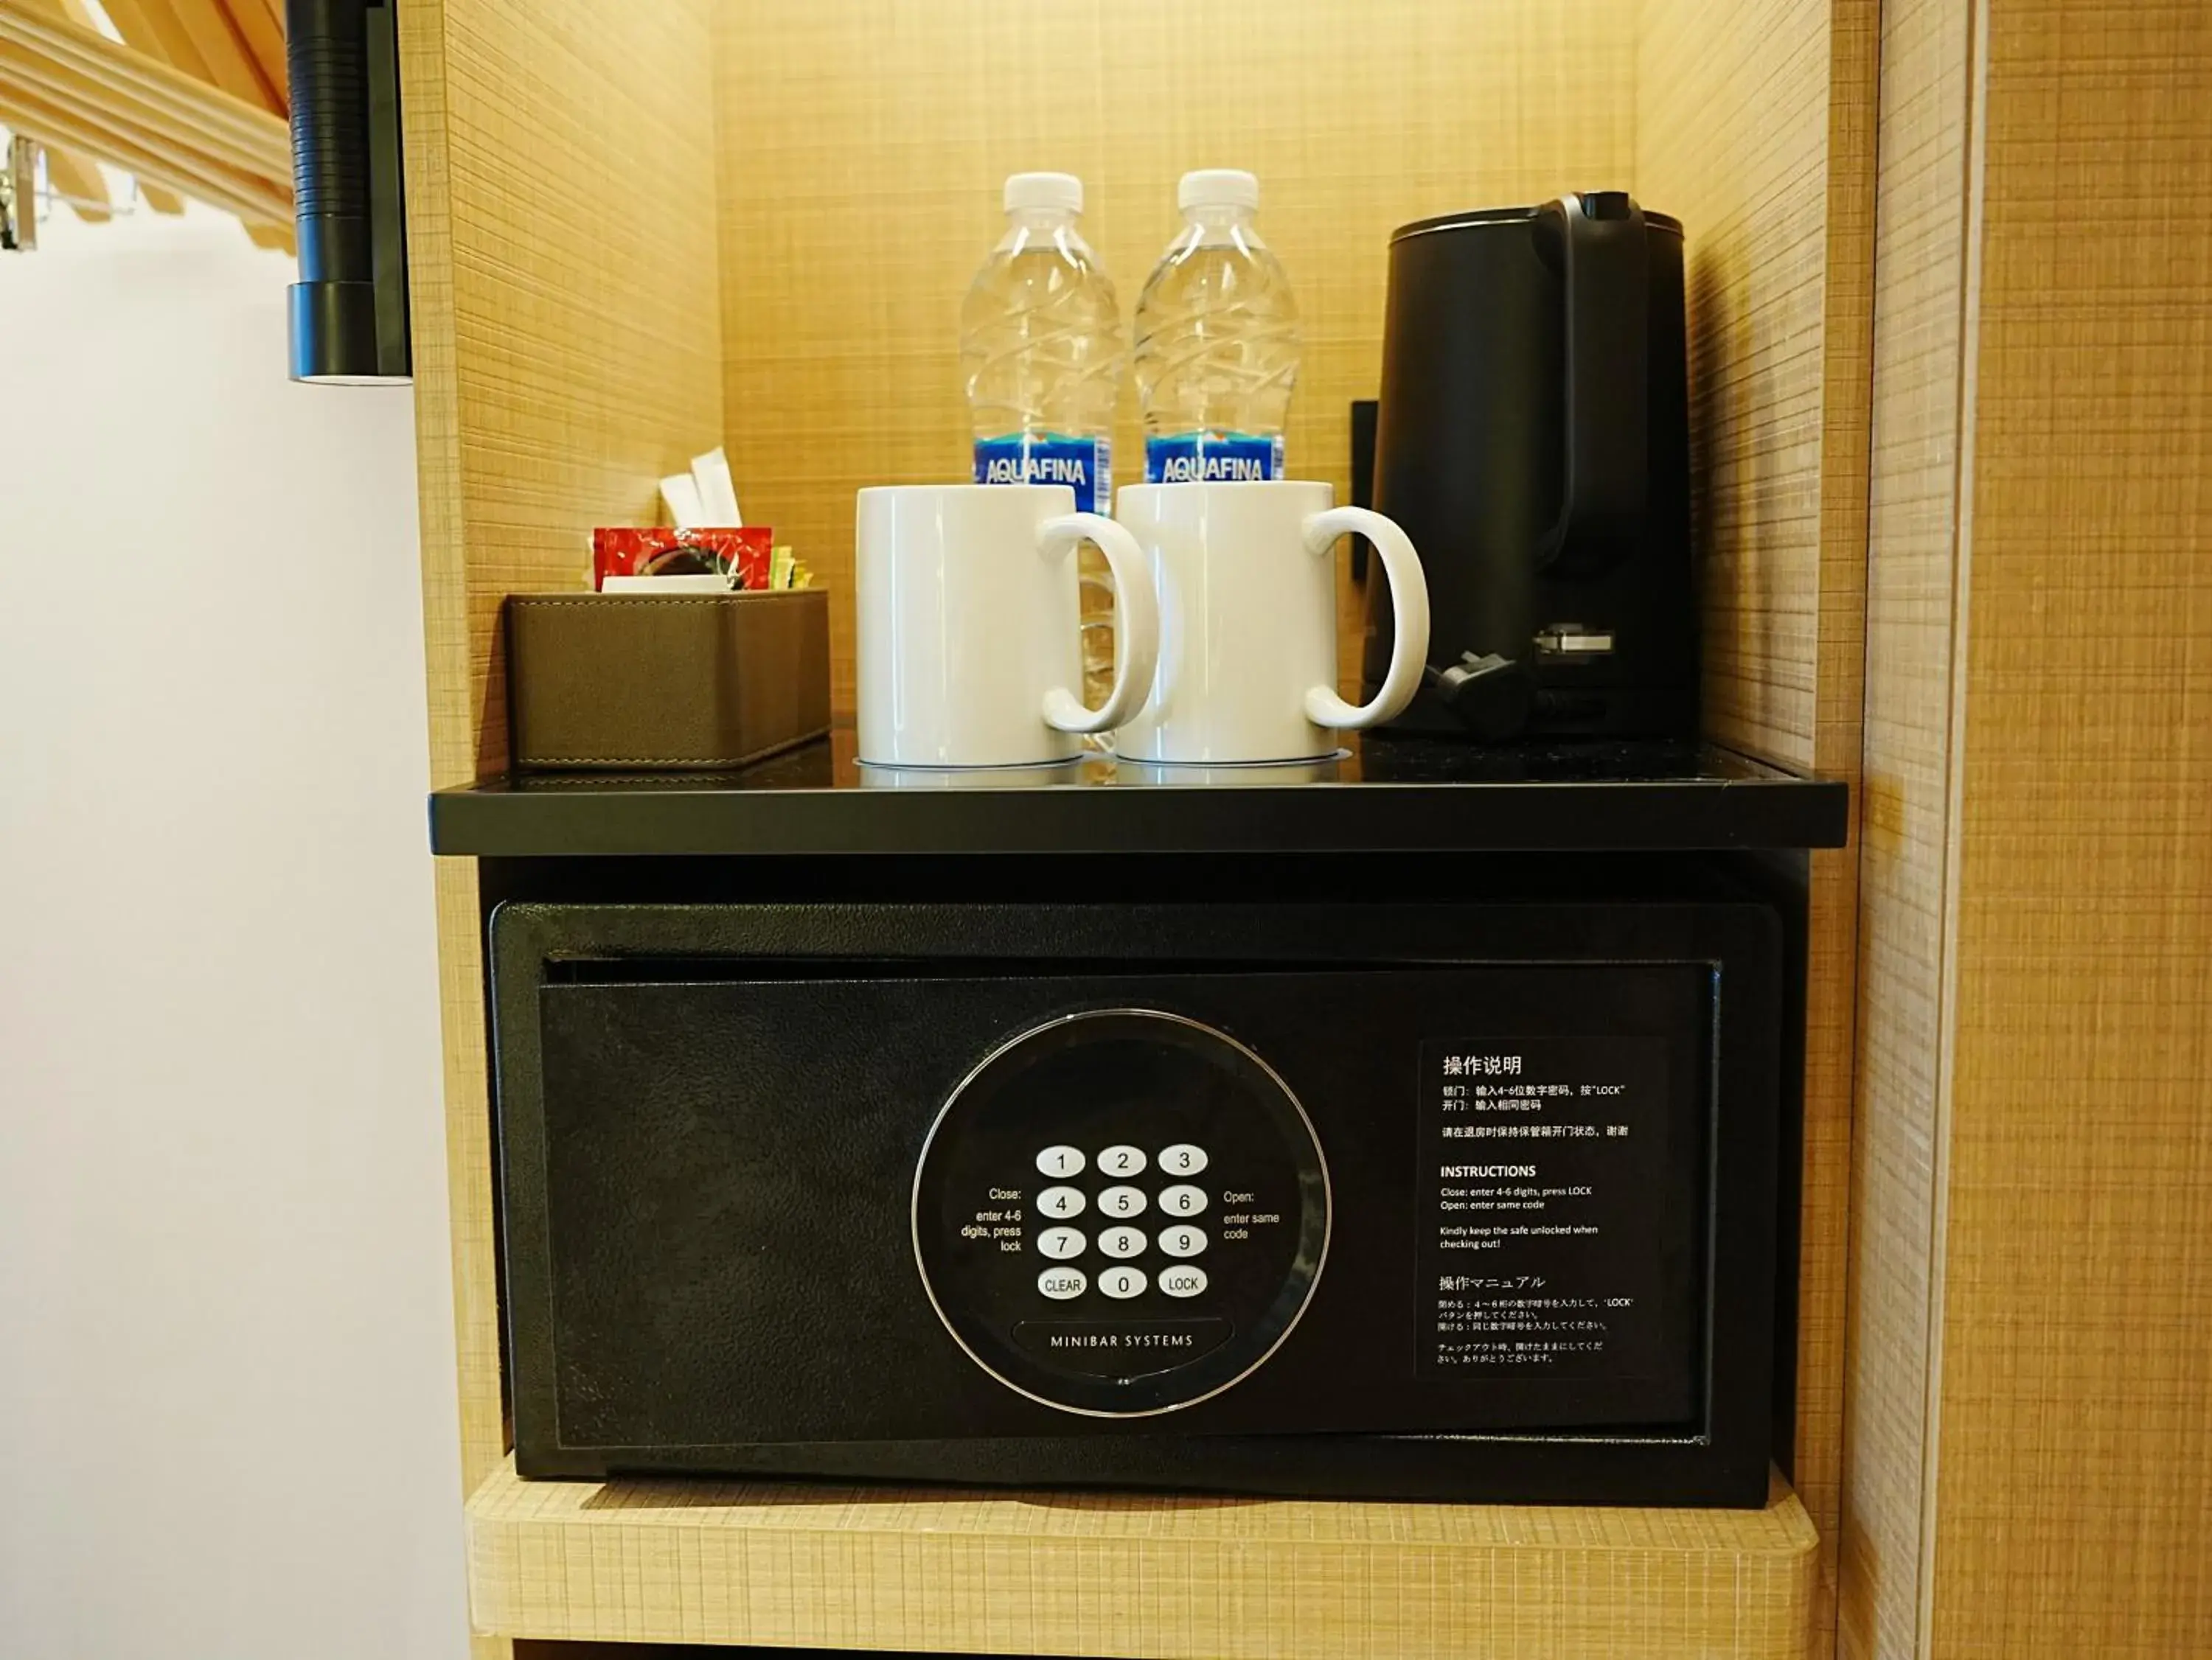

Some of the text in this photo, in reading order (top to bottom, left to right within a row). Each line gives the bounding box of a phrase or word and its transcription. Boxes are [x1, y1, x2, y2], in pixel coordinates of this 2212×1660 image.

[986, 457, 1086, 486] AQUAFINA
[1162, 456, 1263, 484] AQUAFINA
[1442, 1055, 1523, 1075] 操作说明
[1057, 1152, 1191, 1170] 1 2 3
[1440, 1165, 1537, 1178] INSTRUCTIONS
[989, 1188, 1022, 1200] Close:
[1223, 1190, 1254, 1204] Open:
[1440, 1186, 1593, 1198] Close: enter 4-6 digits, press LOCK
[1055, 1193, 1191, 1211] 4 5 6
[1440, 1199, 1545, 1211] Open: enter same code
[975, 1210, 1022, 1222] enter 4-6
[1223, 1213, 1280, 1224] enter same
[961, 1224, 1022, 1239] digits, press
[1223, 1228, 1248, 1240] code
[1439, 1225, 1599, 1237] Kindly keep the safe unlocked when
[1000, 1240, 1022, 1252] lock
[1057, 1235, 1190, 1252] 7 8 9
[1439, 1238, 1500, 1250] checking out!
[1045, 1277, 1198, 1292] CLEAR 0 LOCK
[1439, 1275, 1546, 1291] 操作マニュアル
[1051, 1335, 1193, 1347] MINIBAR SYSTEMS
